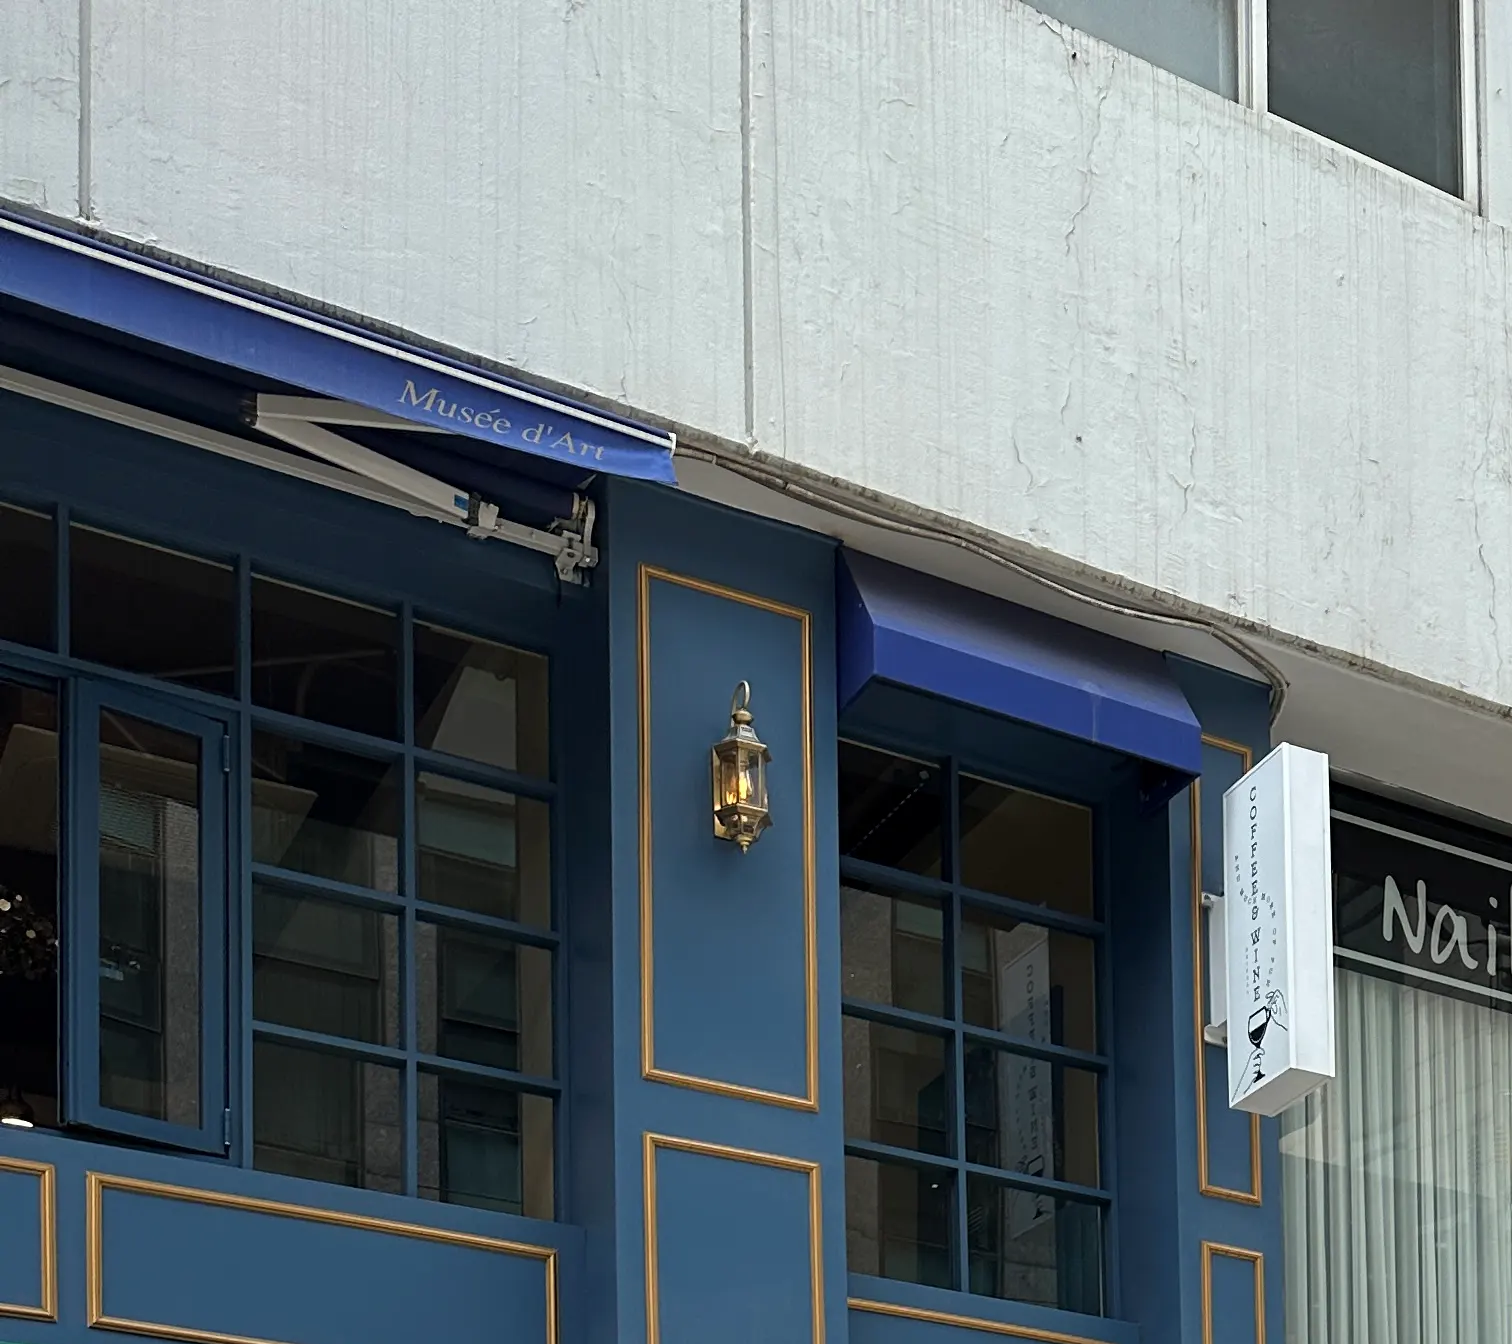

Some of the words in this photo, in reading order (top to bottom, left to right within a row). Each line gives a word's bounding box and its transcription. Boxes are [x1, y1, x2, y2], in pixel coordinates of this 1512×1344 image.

[397, 379, 512, 437] Musée
[520, 422, 608, 464] d'Art
[1248, 786, 1259, 897] COFFEE
[1250, 926, 1262, 1003] WINE
